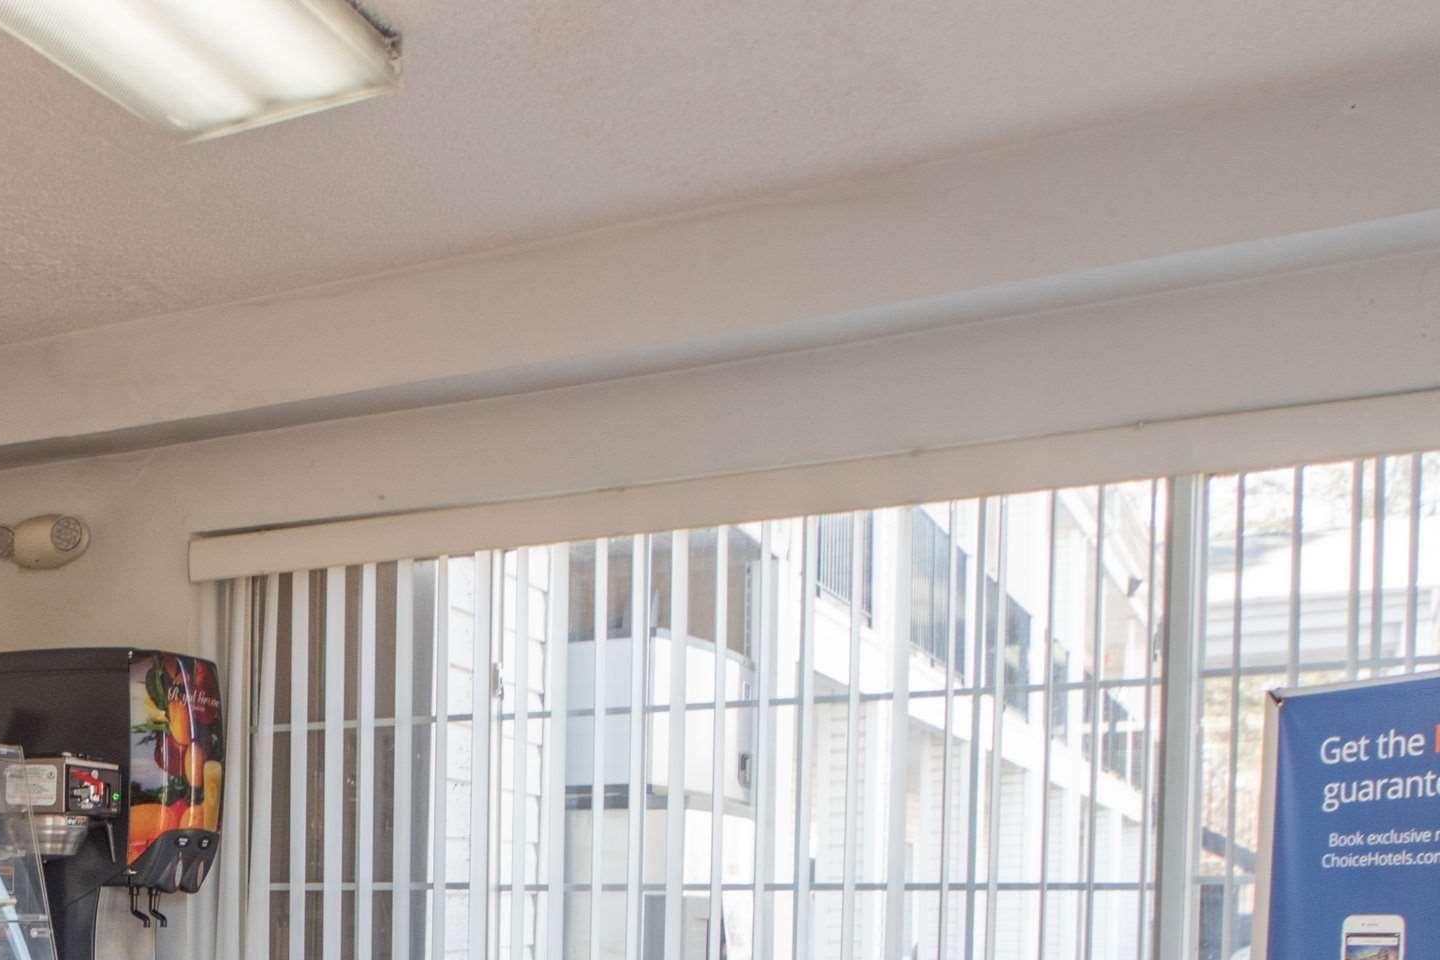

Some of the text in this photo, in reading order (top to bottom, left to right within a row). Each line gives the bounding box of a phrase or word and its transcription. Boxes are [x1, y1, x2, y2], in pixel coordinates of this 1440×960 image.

[1320, 736, 1371, 765] Get
[1376, 728, 1426, 759] the
[1328, 831, 1364, 848] Book
[1366, 828, 1432, 845] exclusive
